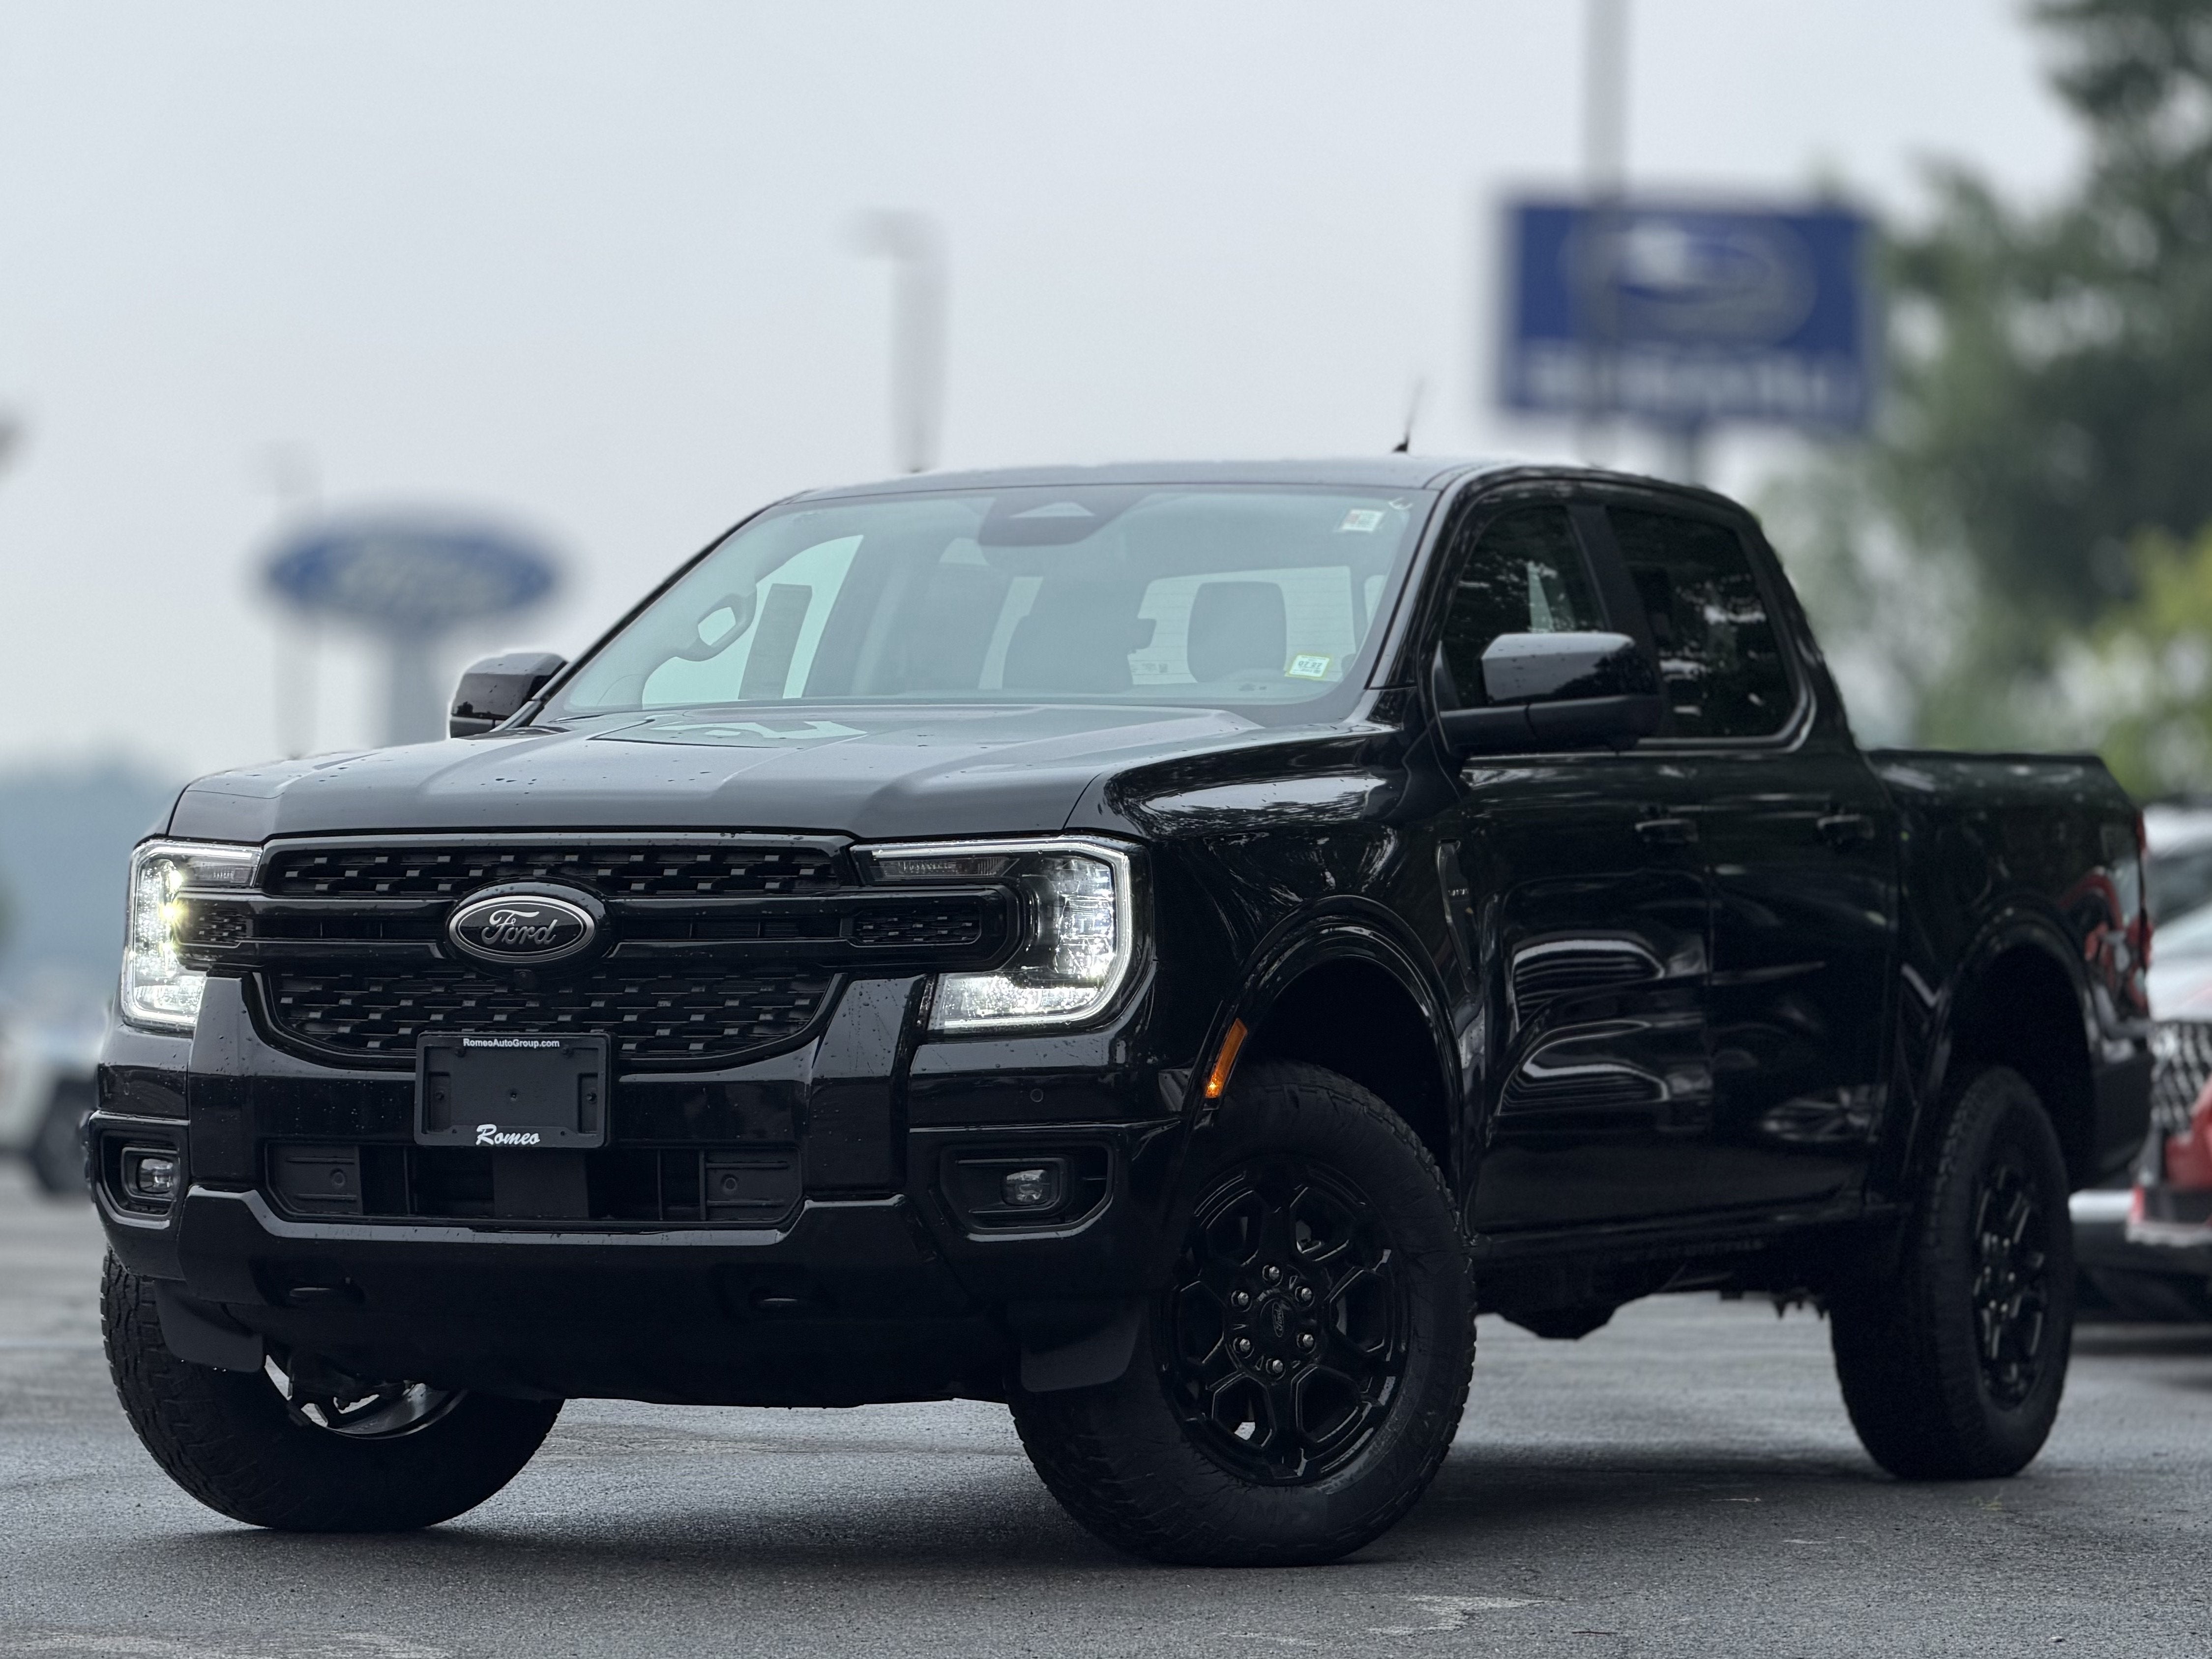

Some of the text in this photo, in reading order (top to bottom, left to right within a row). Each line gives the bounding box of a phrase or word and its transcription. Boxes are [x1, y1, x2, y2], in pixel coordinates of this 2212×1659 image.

[481, 909, 558, 945] Ford
[463, 1038, 560, 1049] RomeoAutoGroup.com
[476, 1124, 540, 1145] Romeo
[1274, 1308, 1283, 1332] Ford
